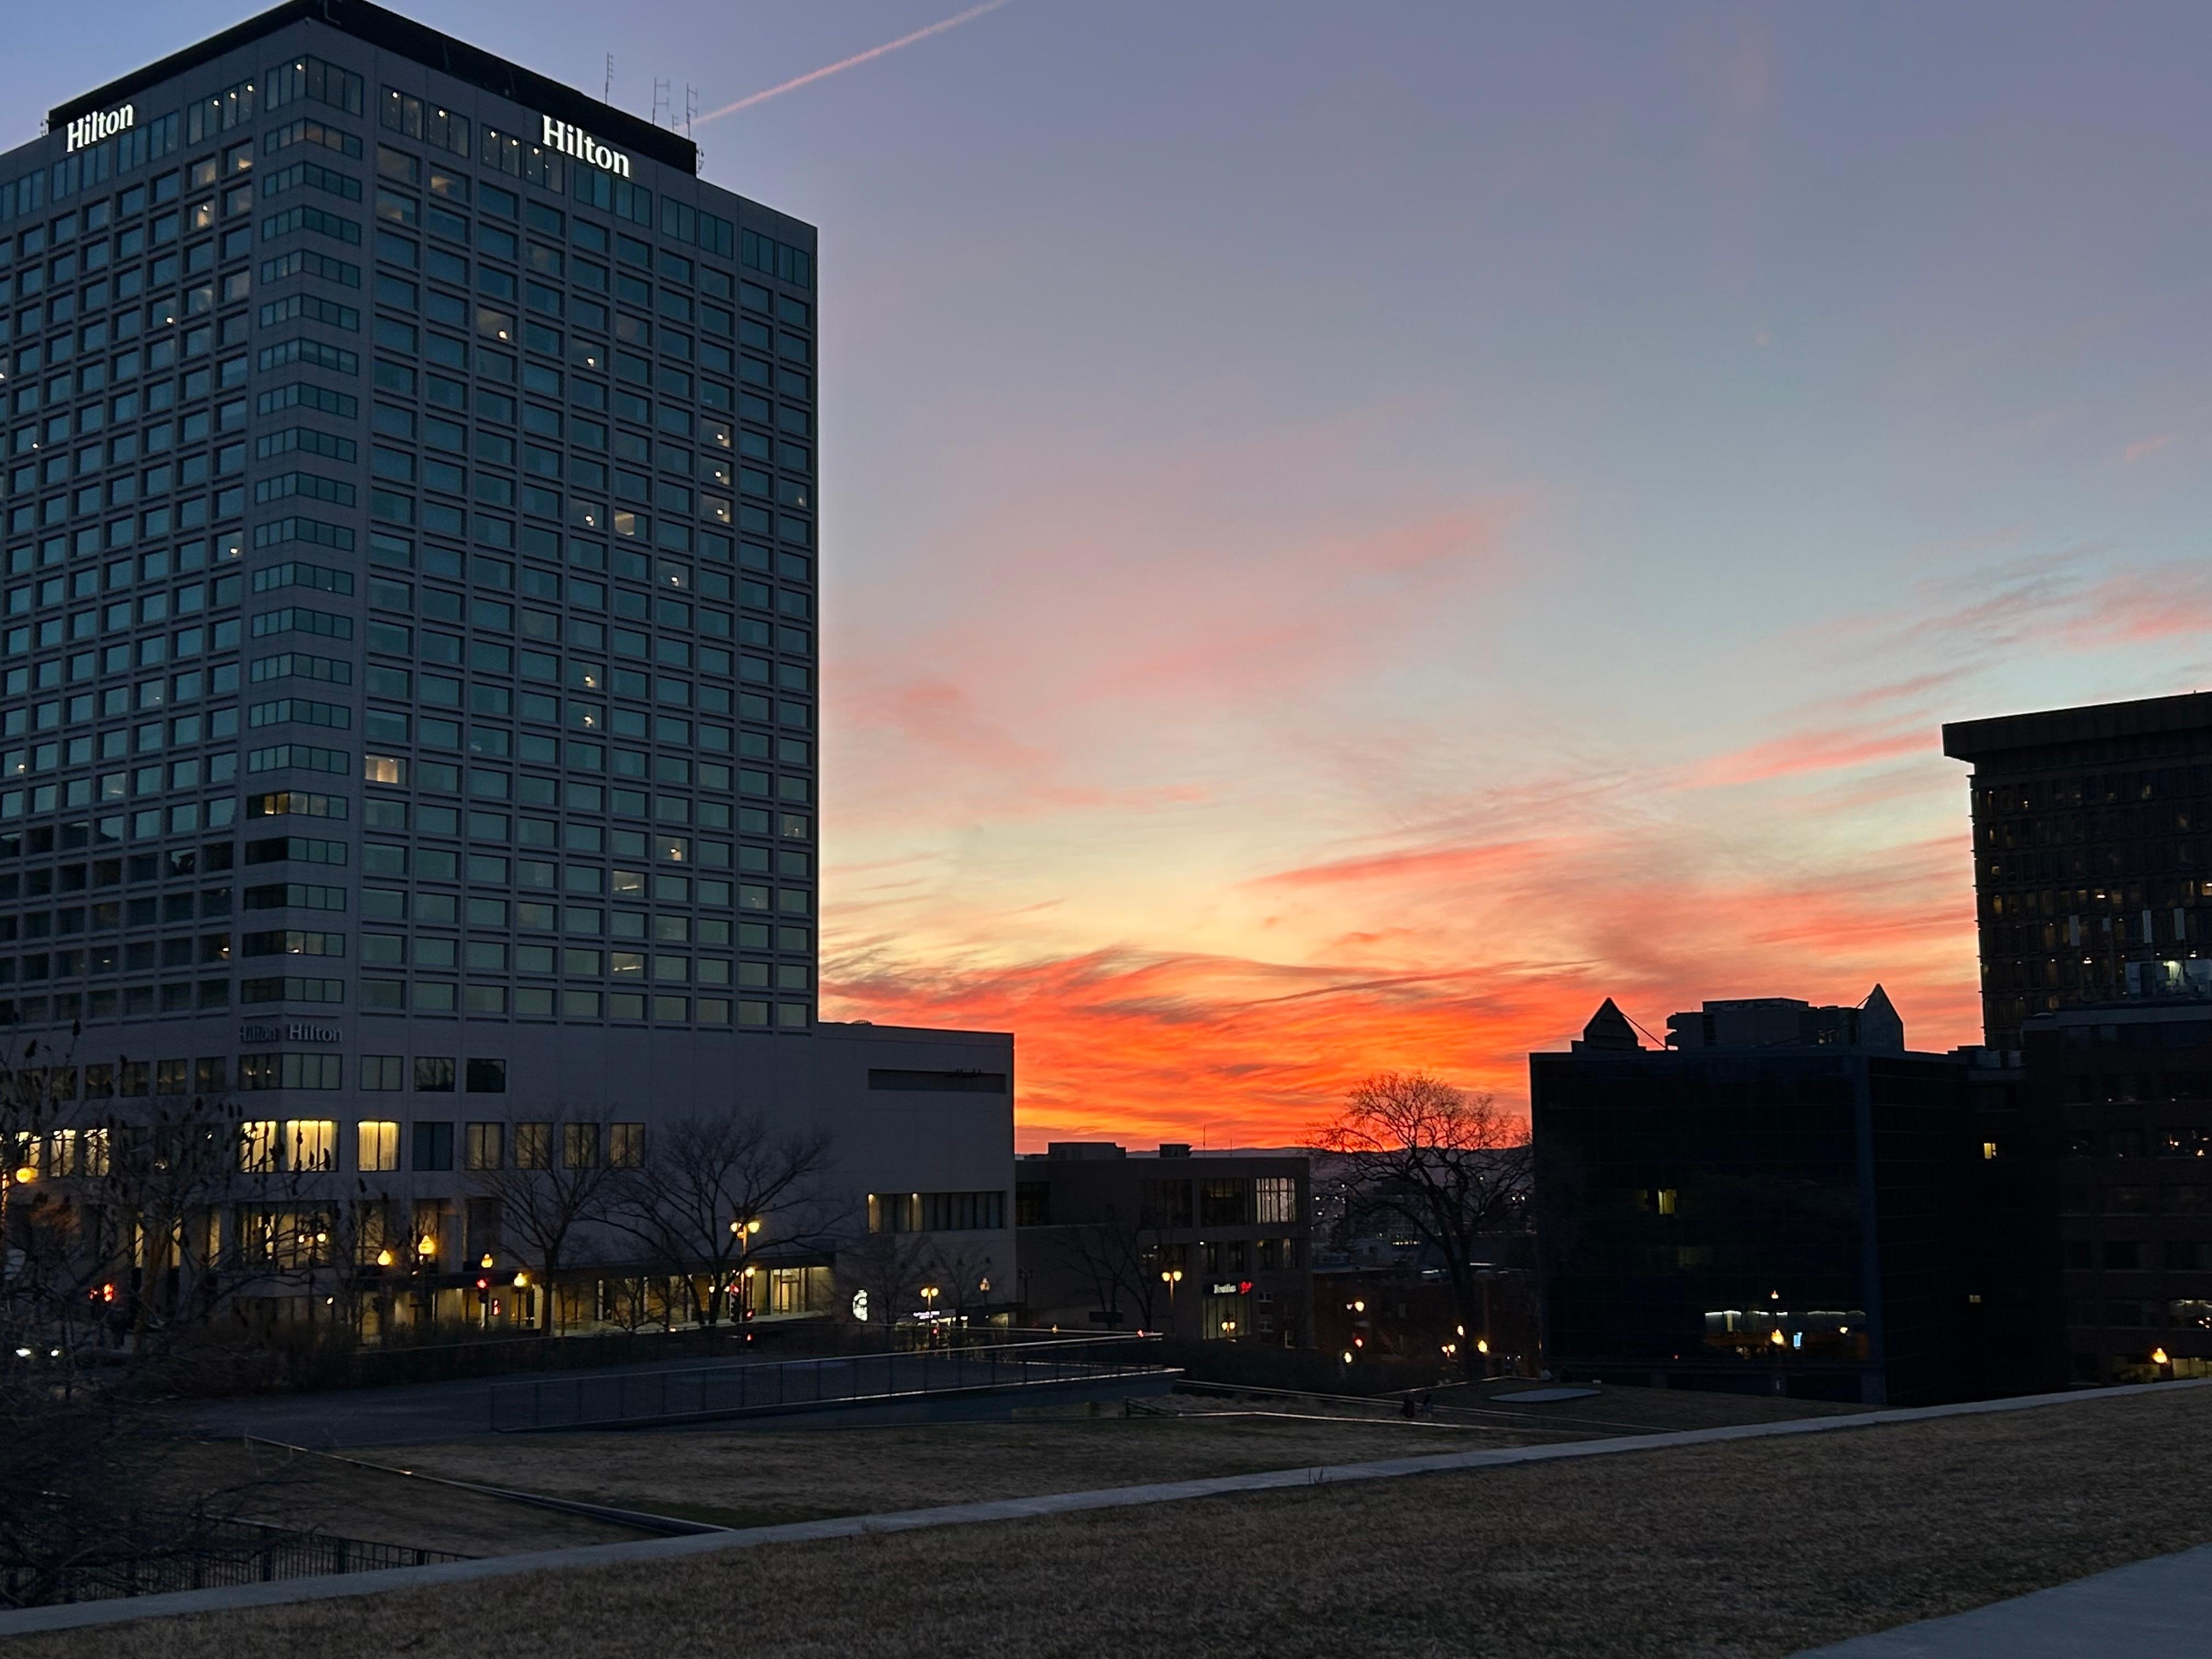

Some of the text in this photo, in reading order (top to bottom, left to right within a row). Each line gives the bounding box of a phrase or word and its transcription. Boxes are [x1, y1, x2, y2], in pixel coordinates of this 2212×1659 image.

[66, 104, 133, 153] Hilton
[543, 114, 630, 178] Hilton
[288, 1023, 342, 1042] Hilton
